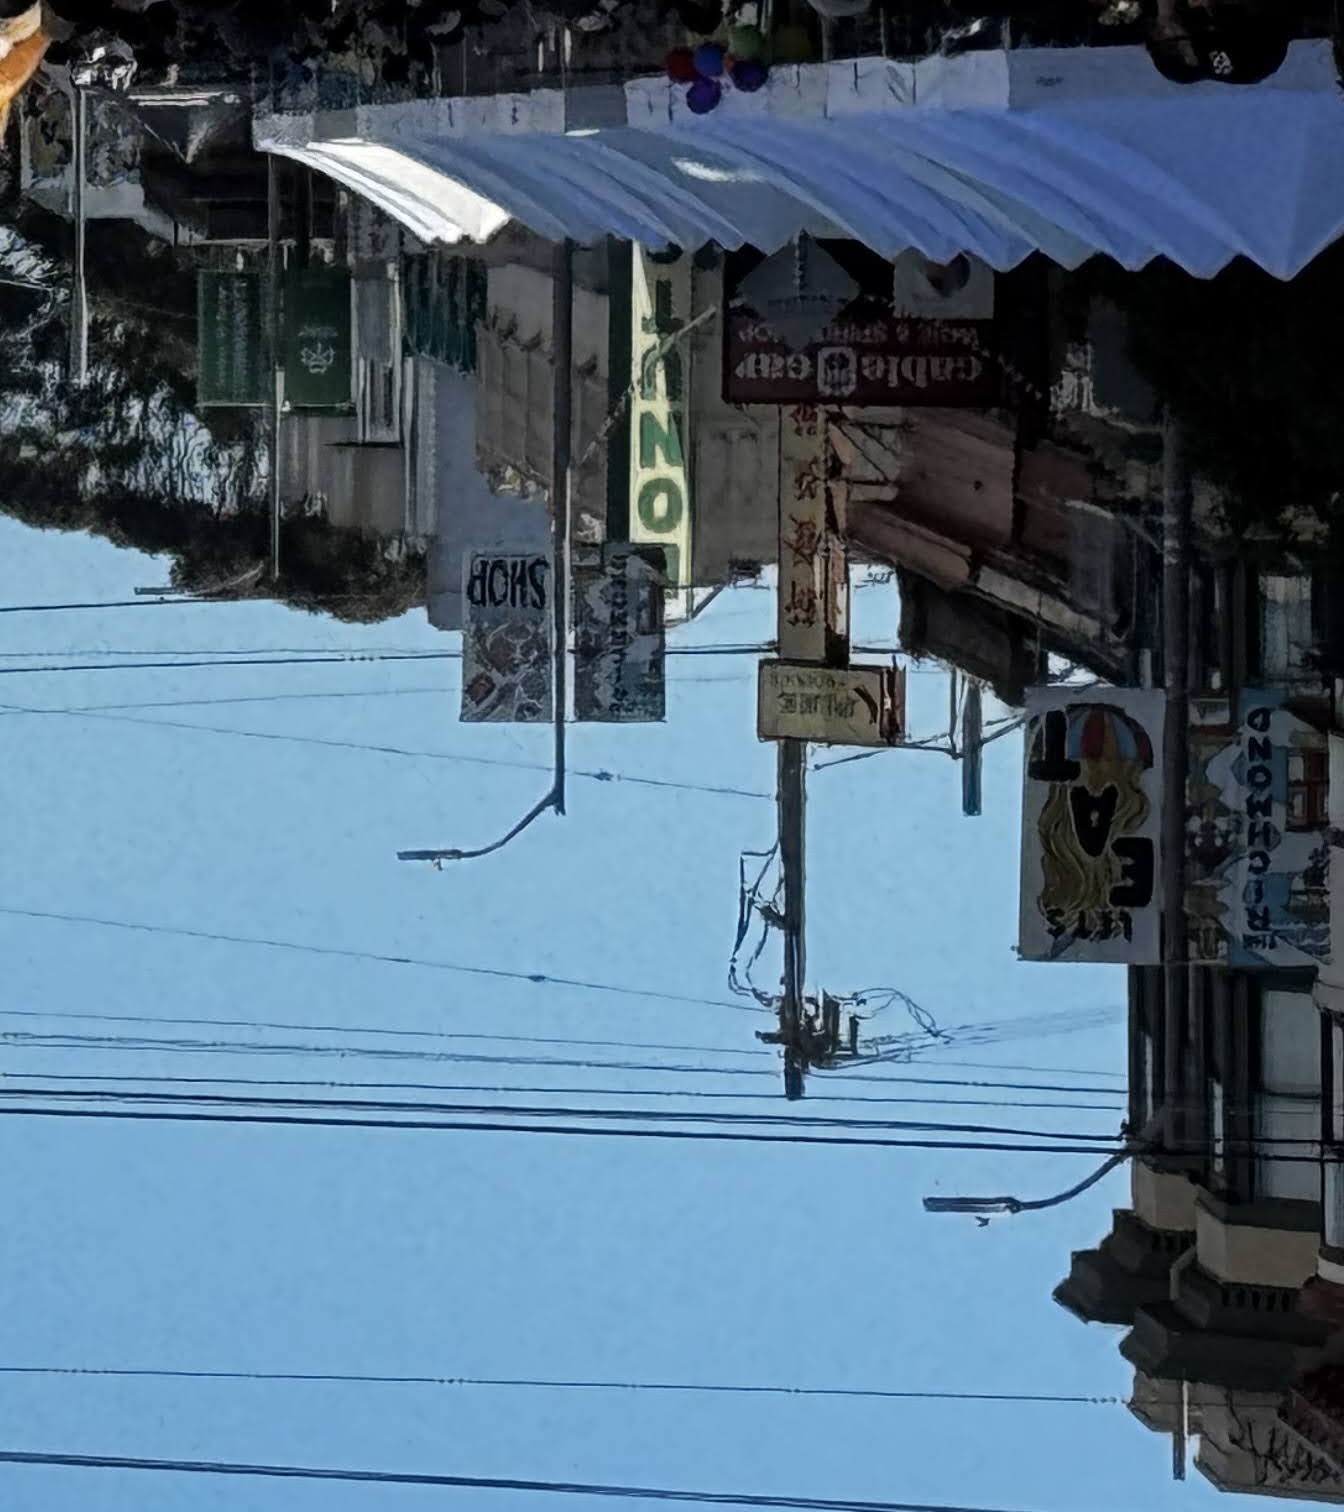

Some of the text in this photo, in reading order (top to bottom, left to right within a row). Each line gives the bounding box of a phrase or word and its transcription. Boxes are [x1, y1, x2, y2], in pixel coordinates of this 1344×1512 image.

[638, 244, 686, 588] ONUT
[467, 557, 551, 610] SHOP
[1246, 708, 1273, 931] RICHMOND
